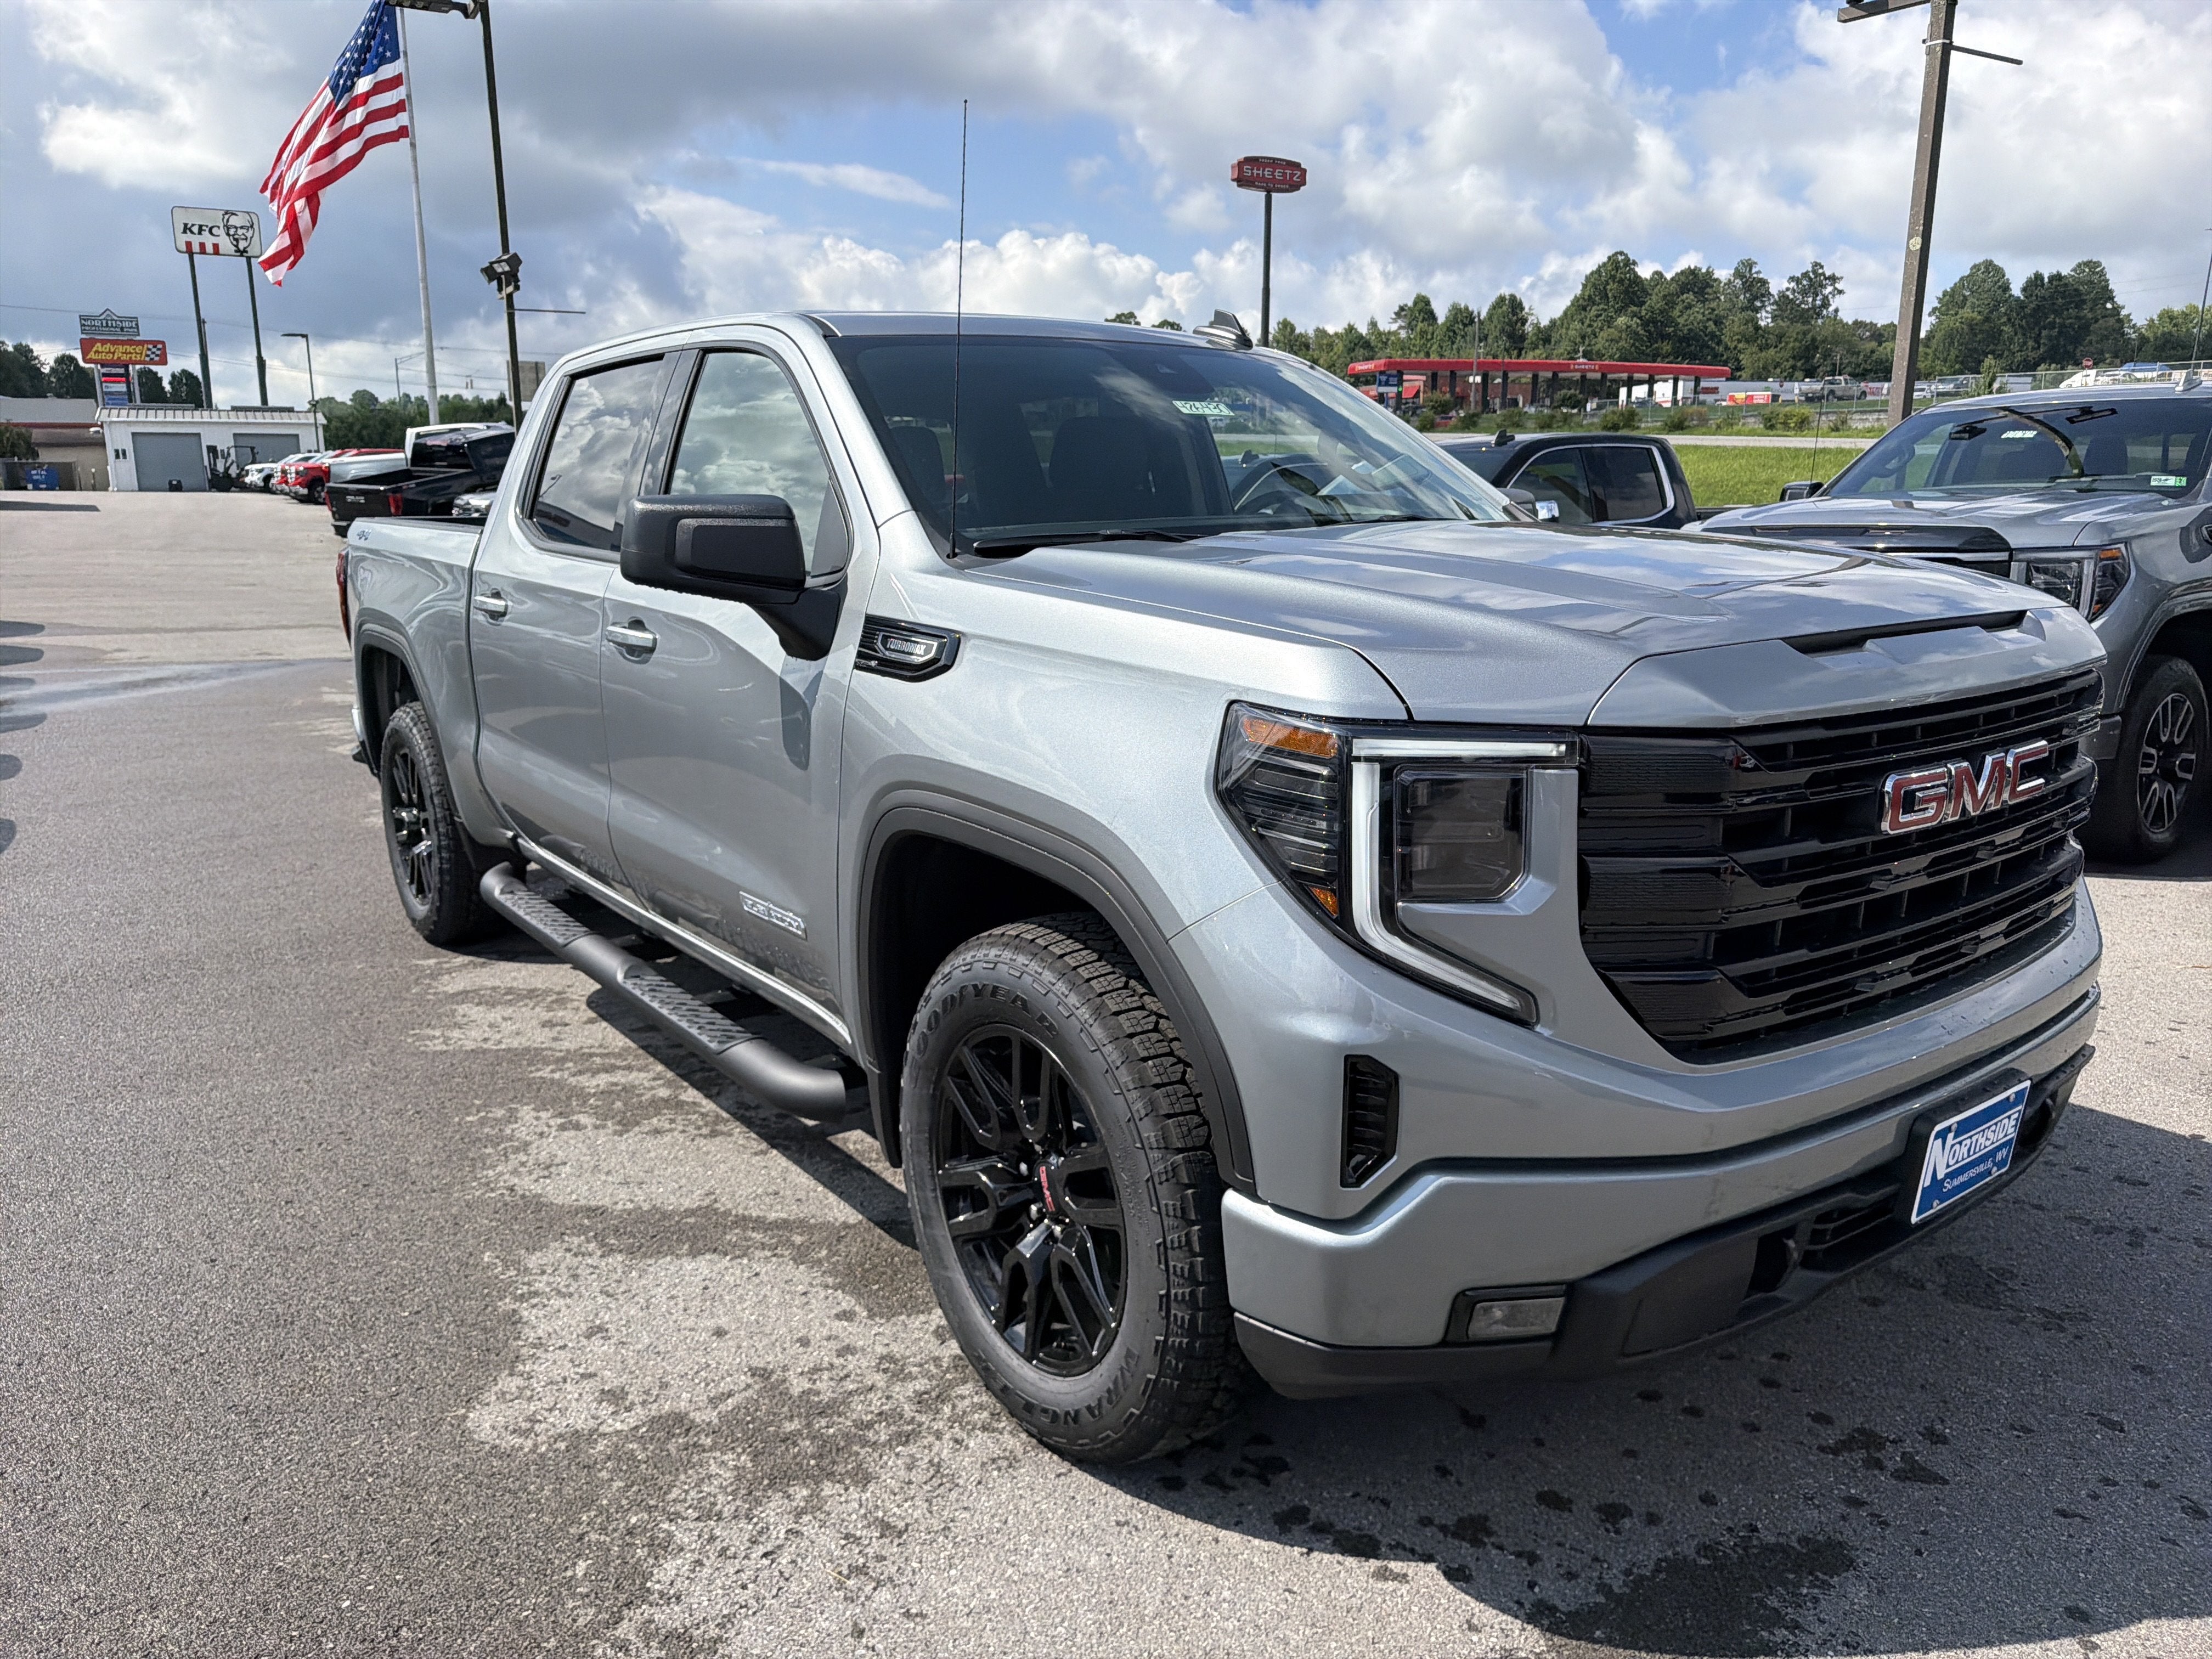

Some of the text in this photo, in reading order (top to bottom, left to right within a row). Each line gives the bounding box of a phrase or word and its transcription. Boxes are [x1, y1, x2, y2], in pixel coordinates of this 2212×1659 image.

[1243, 166, 1301, 182] SHEETZ
[181, 222, 221, 237] KFC
[81, 319, 137, 328] NORTHSIDE
[86, 351, 141, 360] Auto Parts
[92, 342, 143, 353] Advance
[886, 638, 927, 656] TURBOMAX
[1881, 740, 2049, 834] GMC
[1923, 1111, 2019, 1188] NORTHSIDE
[1995, 1146, 2010, 1164] WV
[1040, 1166, 1056, 1212] GMC
